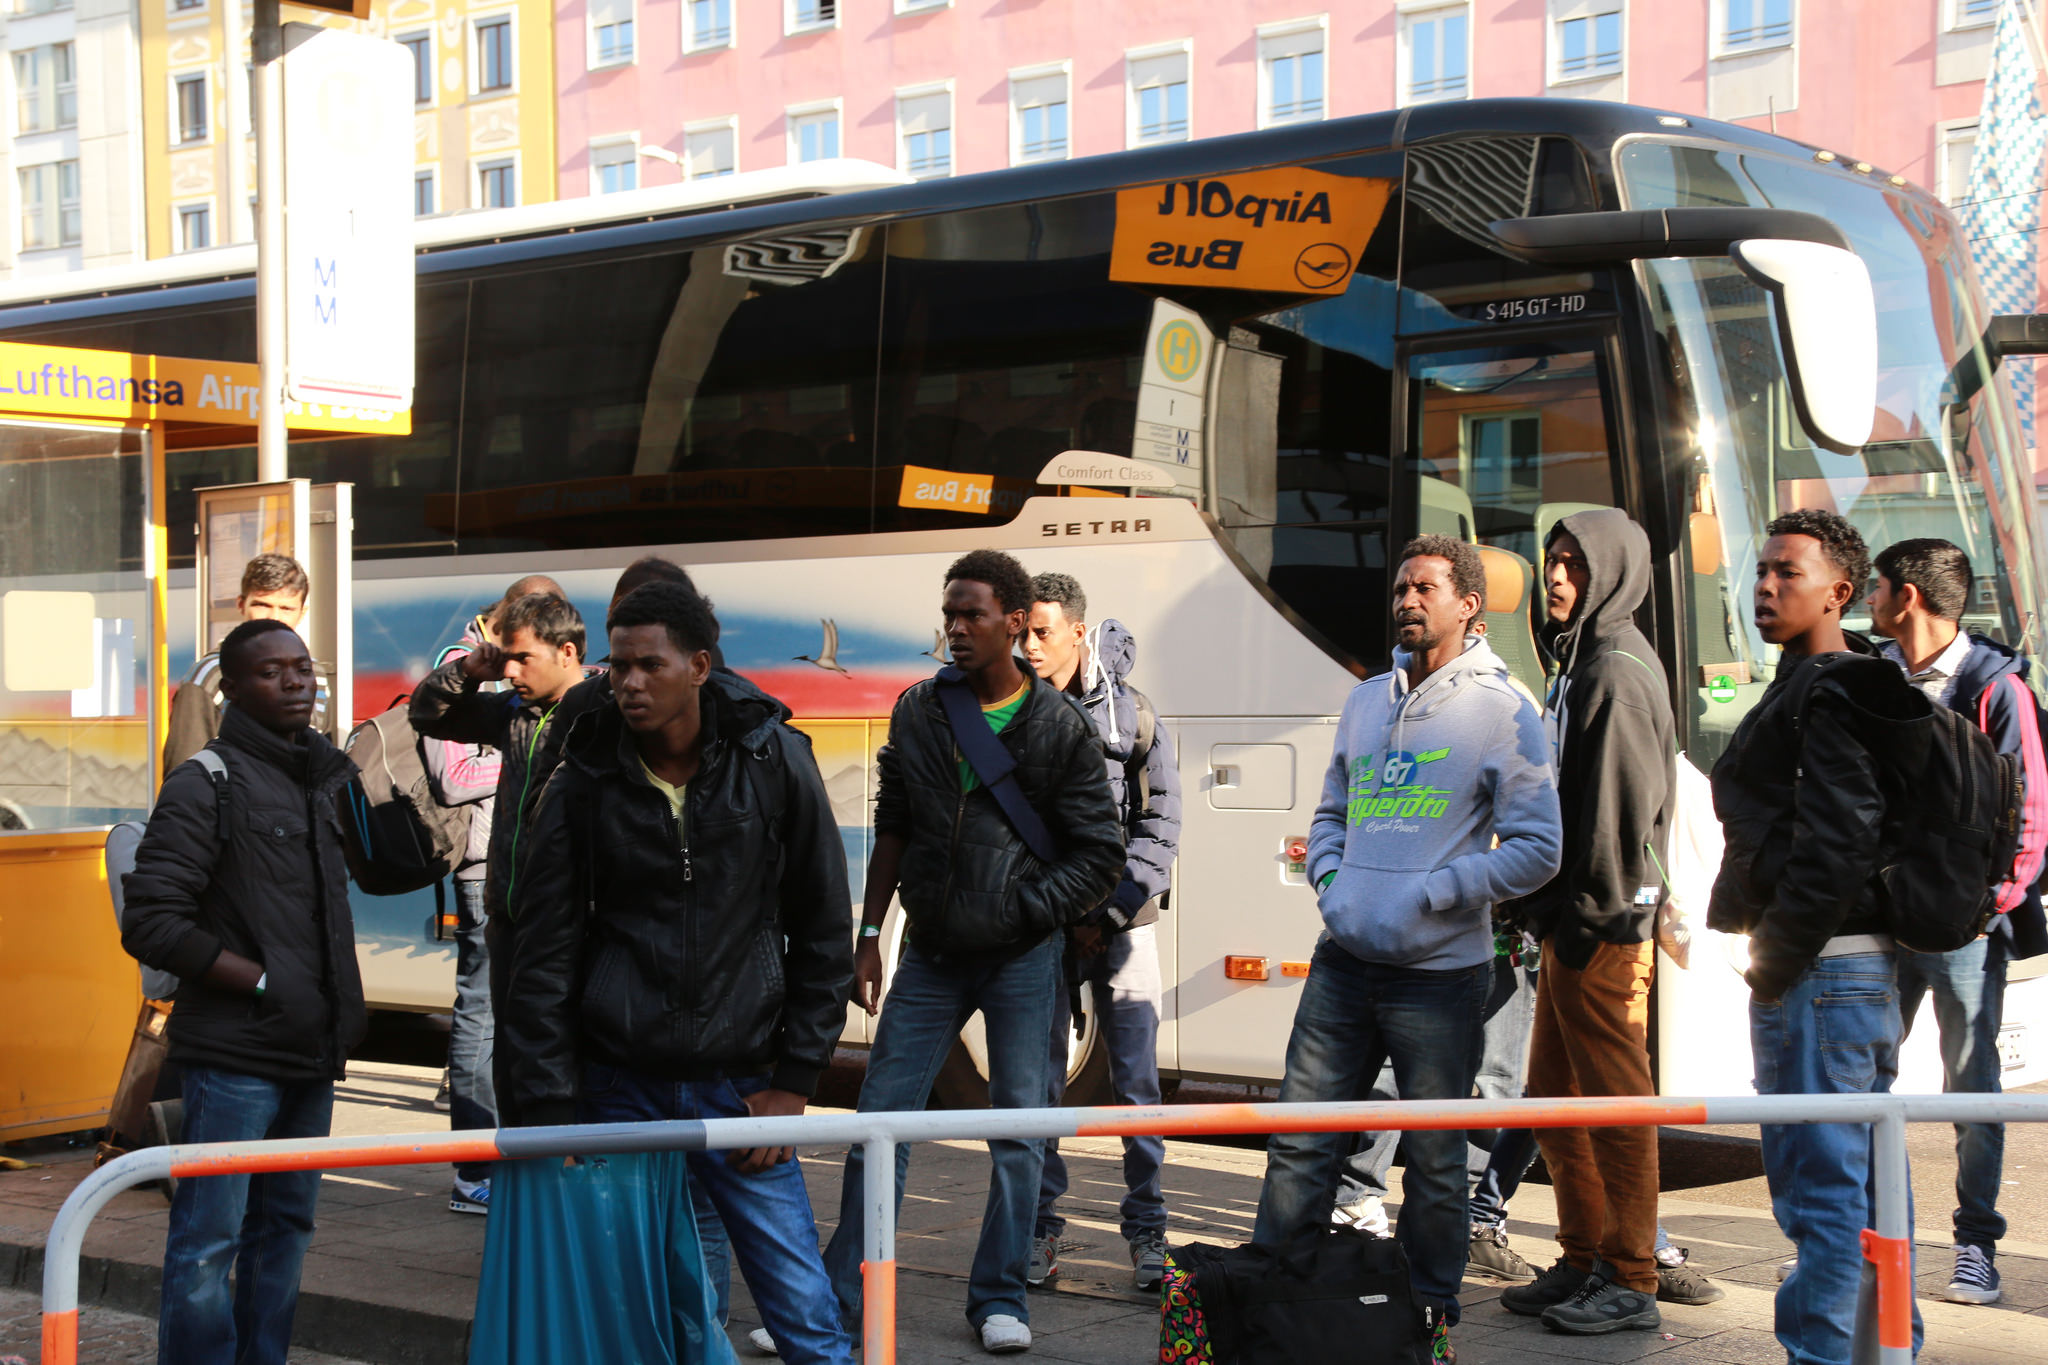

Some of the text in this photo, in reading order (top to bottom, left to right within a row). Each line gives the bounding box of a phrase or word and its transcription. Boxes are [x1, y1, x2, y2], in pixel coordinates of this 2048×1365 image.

[314, 256, 336, 289] M
[314, 294, 337, 326] M
[1486, 303, 1496, 320] S
[1499, 300, 1525, 318] 415
[1057, 464, 1154, 480] Comfort Class
[1042, 519, 1151, 537] SETRA
[1383, 757, 1415, 786] 67
